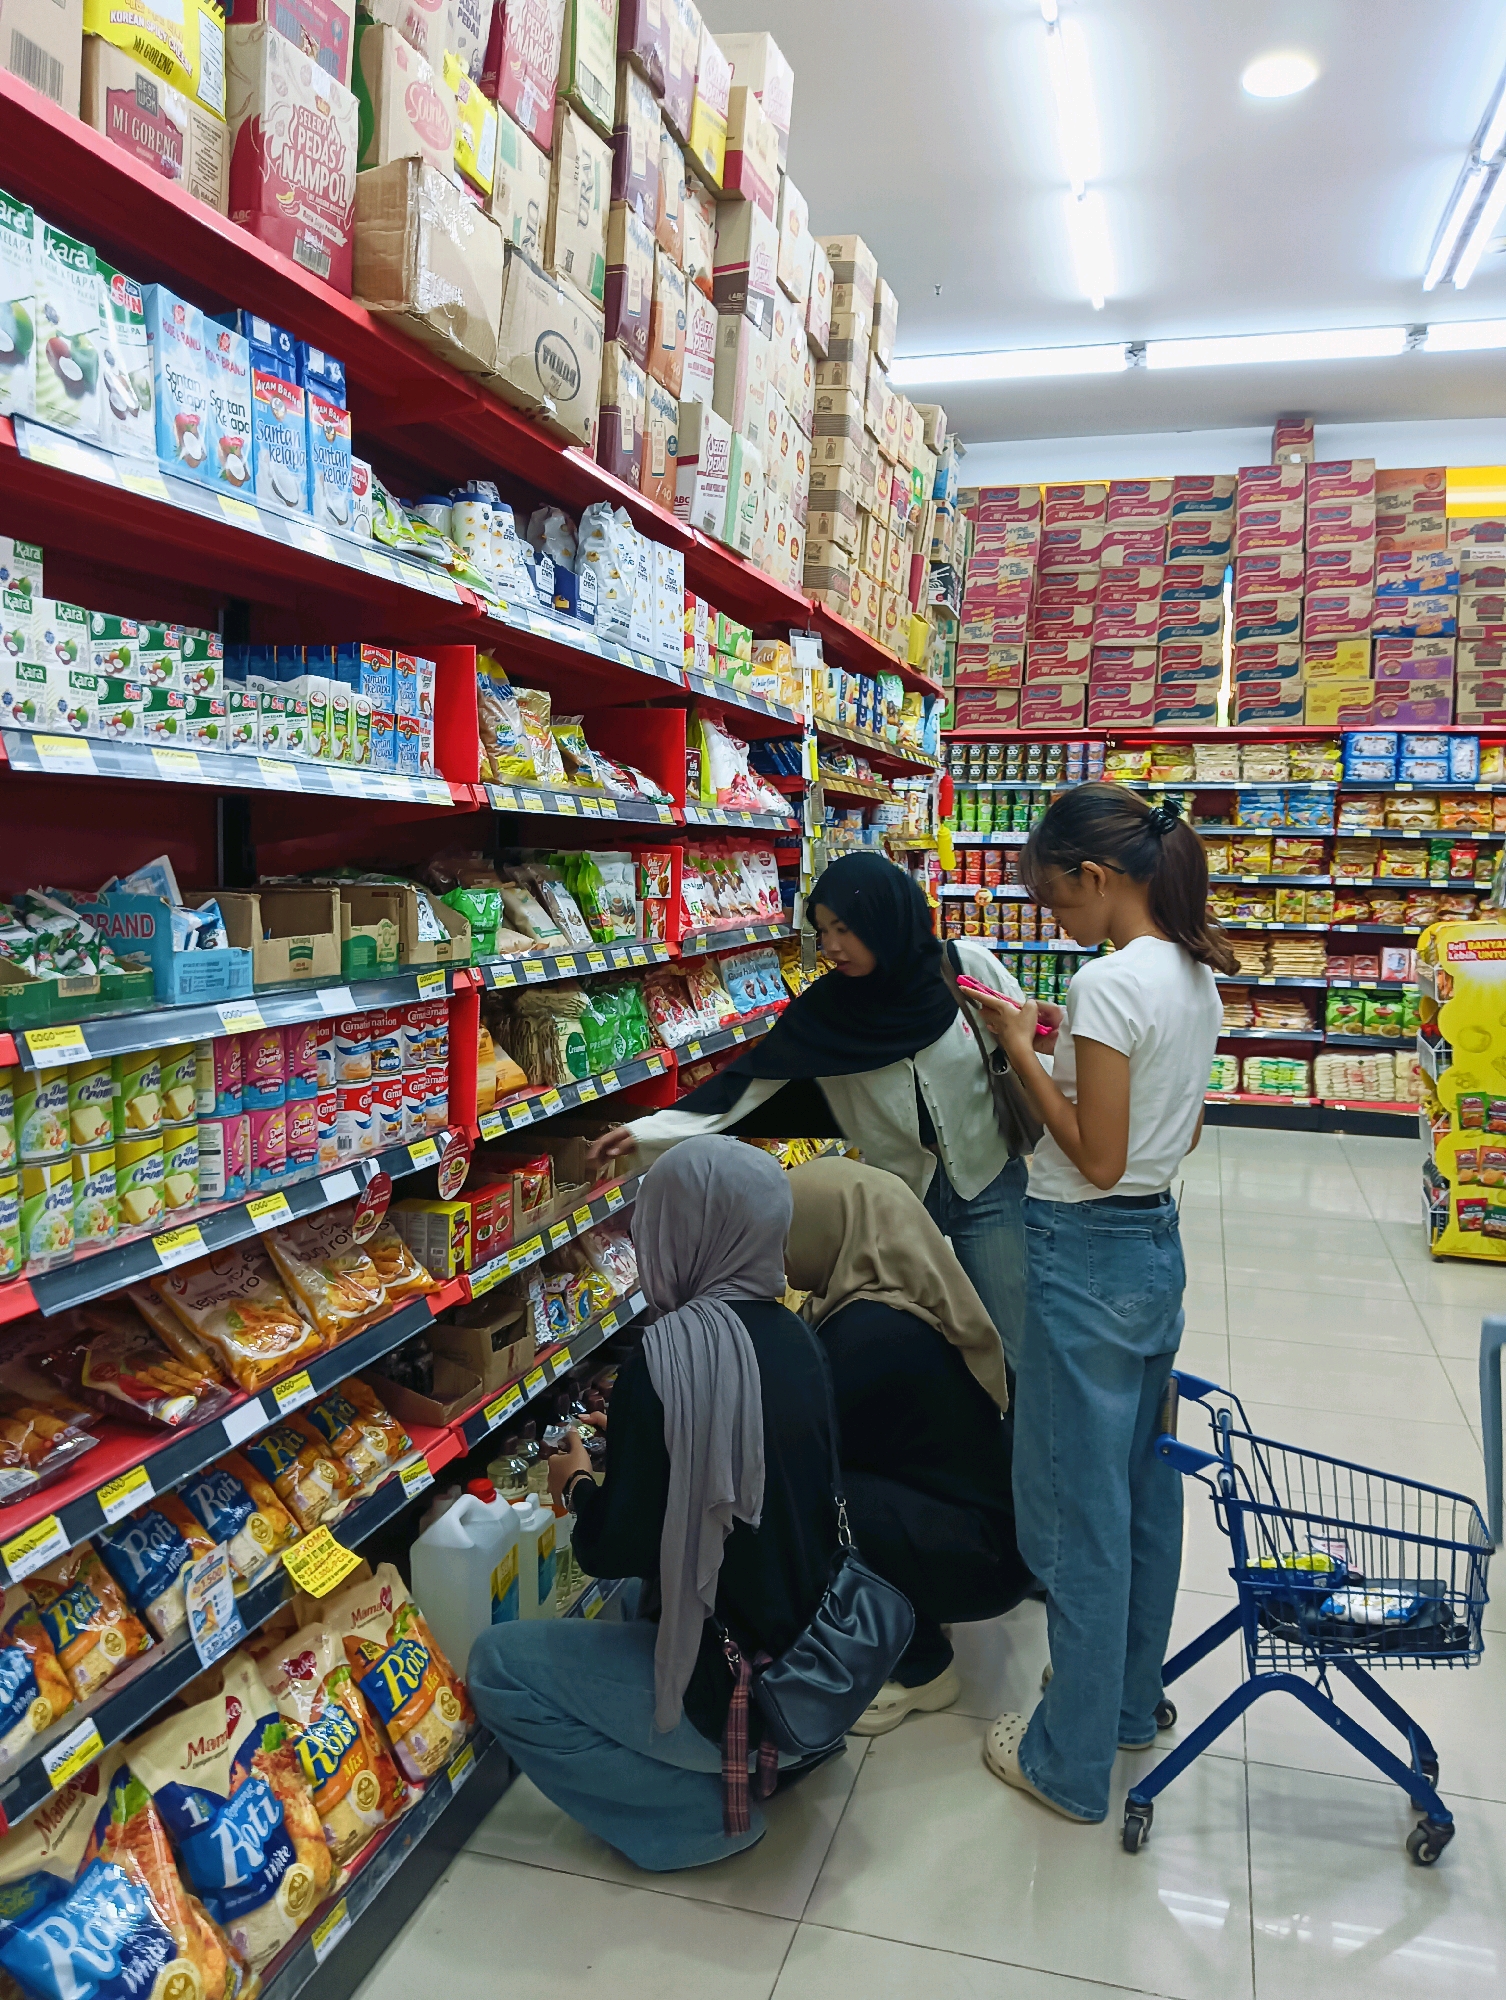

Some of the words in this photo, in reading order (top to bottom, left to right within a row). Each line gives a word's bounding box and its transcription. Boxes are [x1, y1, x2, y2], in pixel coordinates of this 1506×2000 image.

[110, 9, 145, 28] KOREAN
[145, 17, 169, 43] SPICY
[133, 35, 145, 56] MI
[143, 44, 174, 76] GORENG
[138, 79, 156, 97] BEST
[299, 108, 328, 137] SELERA
[113, 105, 128, 134] MI
[132, 117, 179, 161] GORENG
[298, 126, 336, 169] PEDAS
[282, 146, 347, 207] NAMPOL
[0, 203, 27, 232] ara
[233, 210, 251, 221] ABC
[44, 225, 91, 270] kara
[635, 327, 647, 345] 40
[256, 379, 278, 394] AYAM
[278, 383, 303, 409] BRAND
[256, 419, 301, 448] Santan
[268, 445, 306, 469] kelapa
[313, 440, 349, 465] Santan
[631, 464, 639, 479] 40
[662, 488, 672, 501] 40
[674, 496, 690, 504] ABC
[1005, 526, 1029, 535] HYPE
[1407, 518, 1429, 526] HYPE
[1420, 522, 1443, 532] ABIS
[1016, 531, 1036, 540] ABIS
[16, 540, 41, 560] kara
[1416, 551, 1444, 563] HYPE
[999, 563, 1022, 571] HYPE
[1009, 567, 1028, 575] ABIS
[1429, 558, 1453, 568] ABIS
[4, 591, 31, 610] kara
[1412, 599, 1440, 609] HYPE
[1426, 604, 1449, 614] ABIS
[57, 603, 84, 621] kara
[989, 648, 1012, 657] HYPE
[1413, 642, 1436, 651] HYPE
[1425, 648, 1448, 656] ABIS
[999, 654, 1018, 662] ABIS
[17, 661, 45, 680] kara
[70, 671, 96, 689] kara
[1410, 684, 1436, 692] HYPE
[1424, 690, 1447, 698] ABIS
[81, 913, 155, 938] BRAND
[419, 975, 432, 983] GOGO
[222, 1009, 242, 1020] GOGO
[31, 1032, 55, 1043] GOGO
[256, 1054, 282, 1067] Champ
[259, 1048, 280, 1058] Dairy
[291, 1125, 315, 1139] Champ
[293, 1120, 314, 1130] Dairy
[188, 1287, 239, 1312] tepung
[276, 1381, 295, 1396] GOGO
[403, 1472, 418, 1484] GOGO
[100, 1476, 126, 1499] GOGO
[190, 1473, 242, 1530] Roti
[119, 1518, 177, 1583] Roti
[294, 1529, 327, 1556] PROMO
[200, 1566, 223, 1588] 1.500
[52, 1593, 101, 1650] Roti
[351, 1601, 382, 1629] Mama
[377, 1643, 429, 1712] Roti
[424, 1672, 440, 1695] Mix
[294, 1709, 357, 1788] Roti
[343, 1752, 363, 1781] Mix
[210, 1795, 280, 1888] Roti
[264, 1845, 292, 1883] White
[28, 1878, 140, 2000] Roti
[120, 1934, 170, 1995] White
